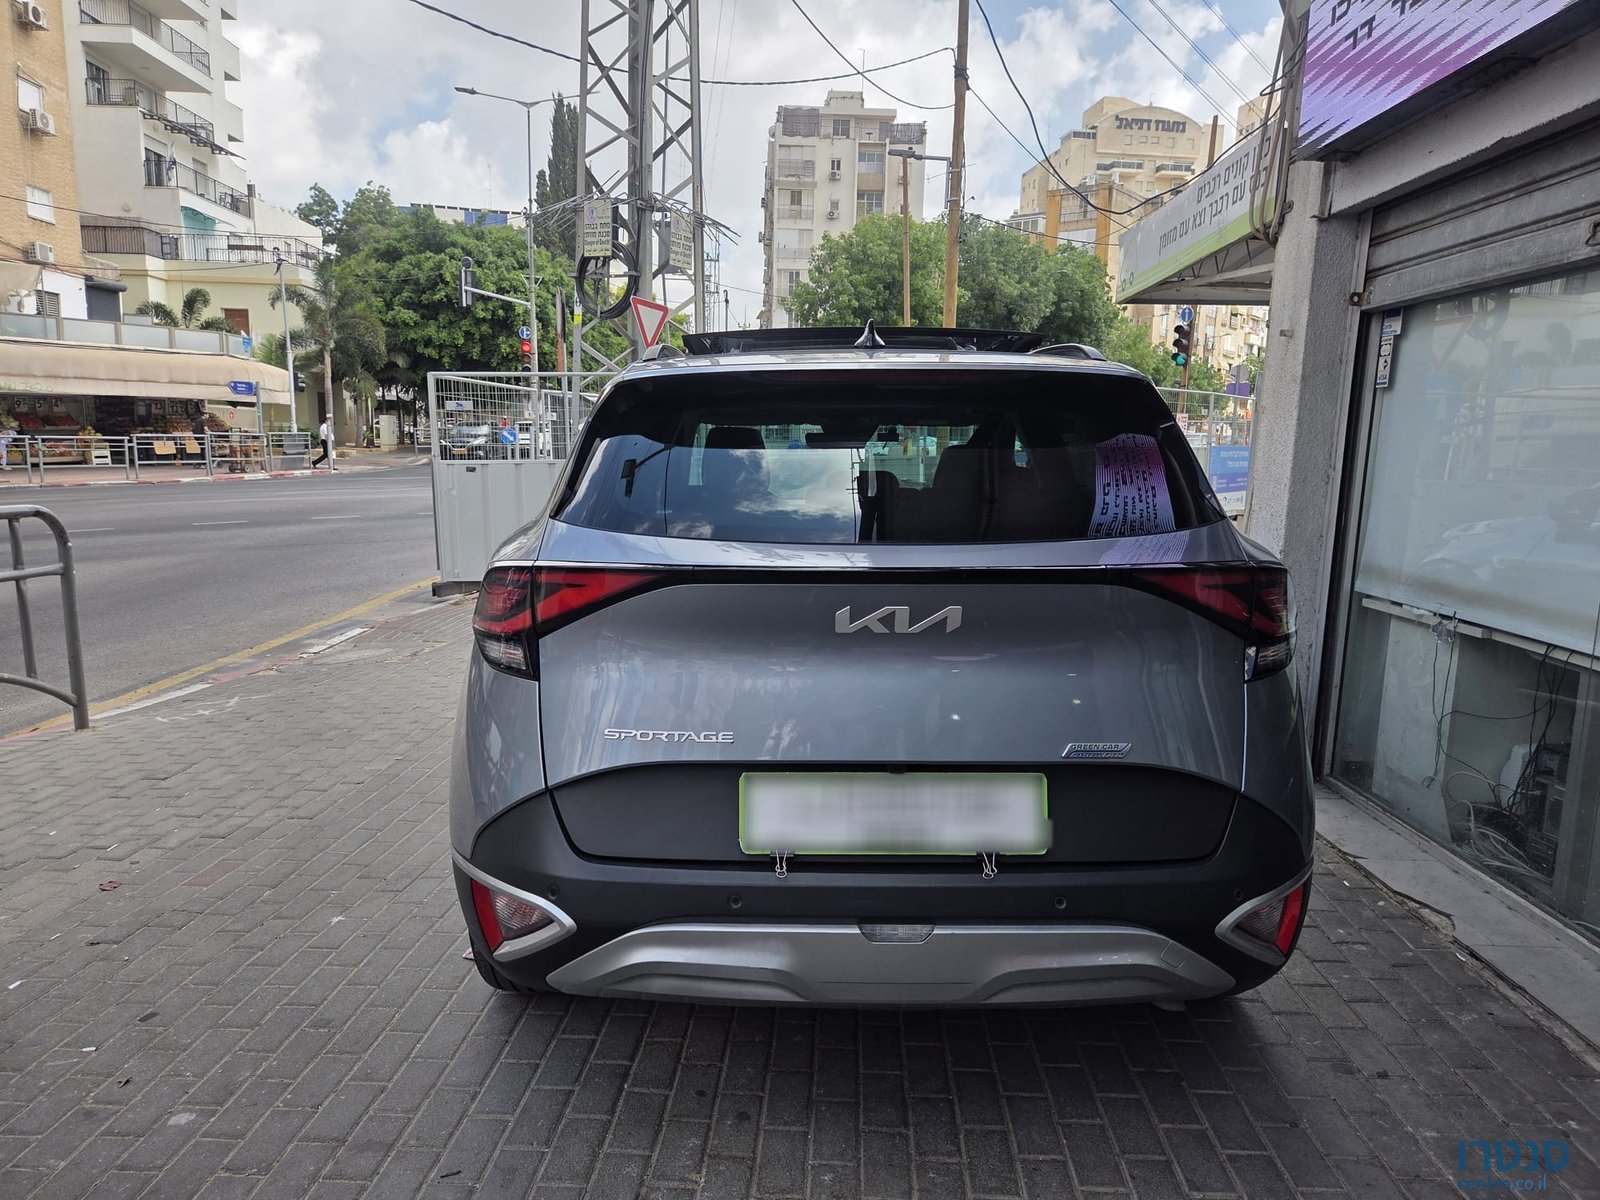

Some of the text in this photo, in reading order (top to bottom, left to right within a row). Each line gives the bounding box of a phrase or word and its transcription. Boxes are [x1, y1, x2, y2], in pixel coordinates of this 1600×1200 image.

[1196, 135, 1271, 204] כן קונים רכבים
[1232, 180, 1247, 206] עם
[1191, 206, 1207, 230] וצא
[1208, 194, 1229, 226] רכבך
[1179, 215, 1191, 239] עם
[1158, 225, 1179, 256] מזומן
[835, 606, 962, 633] KIA
[604, 728, 734, 743] SPORTAGE
